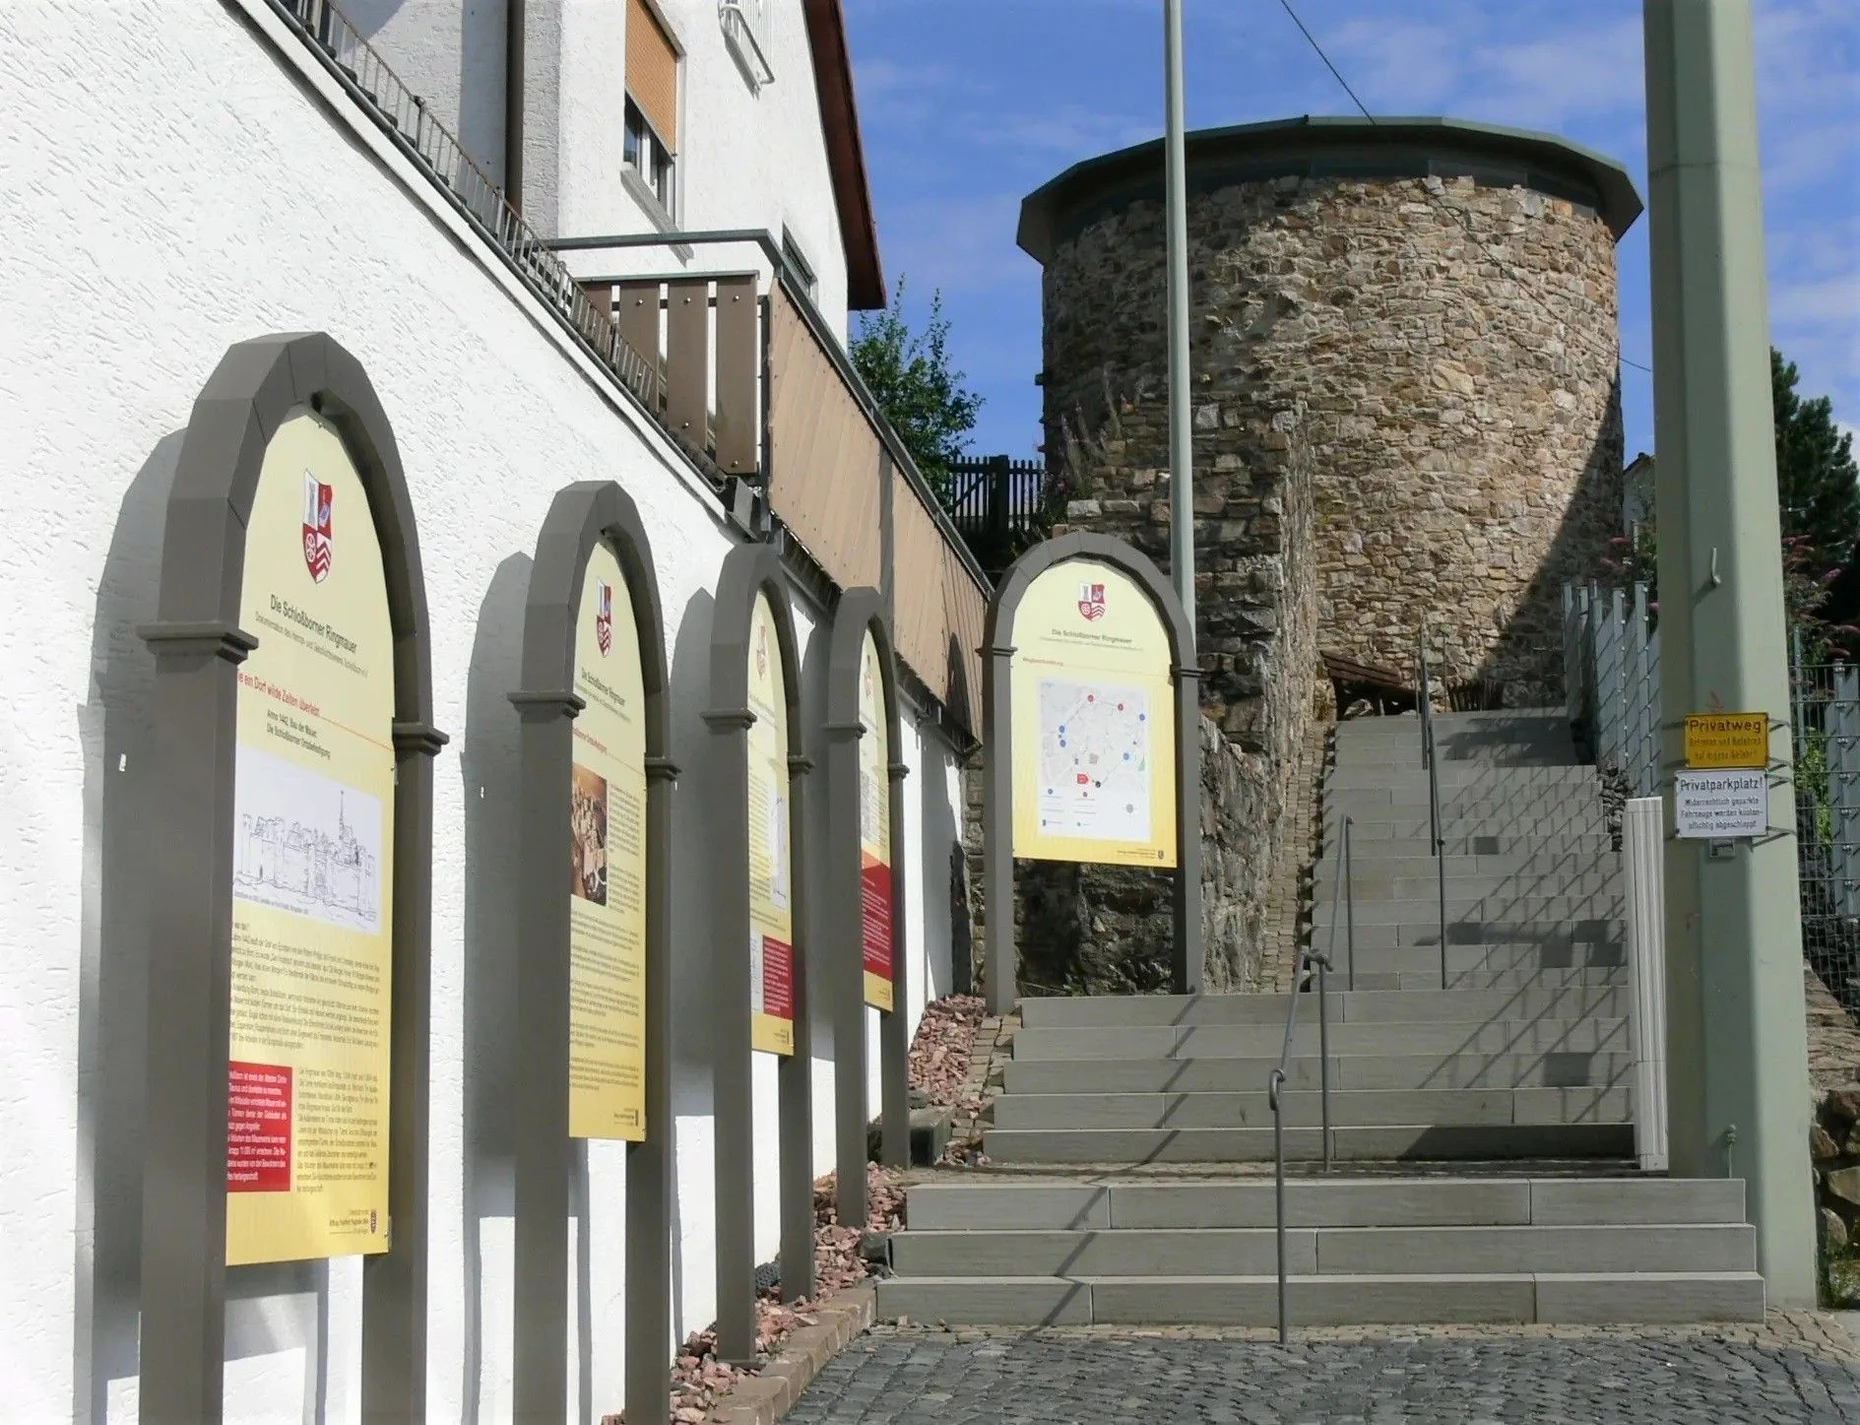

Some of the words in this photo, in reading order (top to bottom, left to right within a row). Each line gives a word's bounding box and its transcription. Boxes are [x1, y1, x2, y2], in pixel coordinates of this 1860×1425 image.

[270, 594, 282, 613] Die
[283, 602, 325, 636] Schloßborner
[326, 624, 358, 653] Ringmauer
[254, 676, 267, 692] Dorf
[1689, 719, 1761, 733] Privatweg
[1680, 777, 1763, 792] Privatparkplatz!
[1685, 796, 1730, 806] Widerrechtlich
[1732, 796, 1759, 806] geparkte
[1681, 809, 1713, 819] Fahrzeuge
[1715, 809, 1736, 817] werden
[1688, 820, 1713, 830] pflichtig
